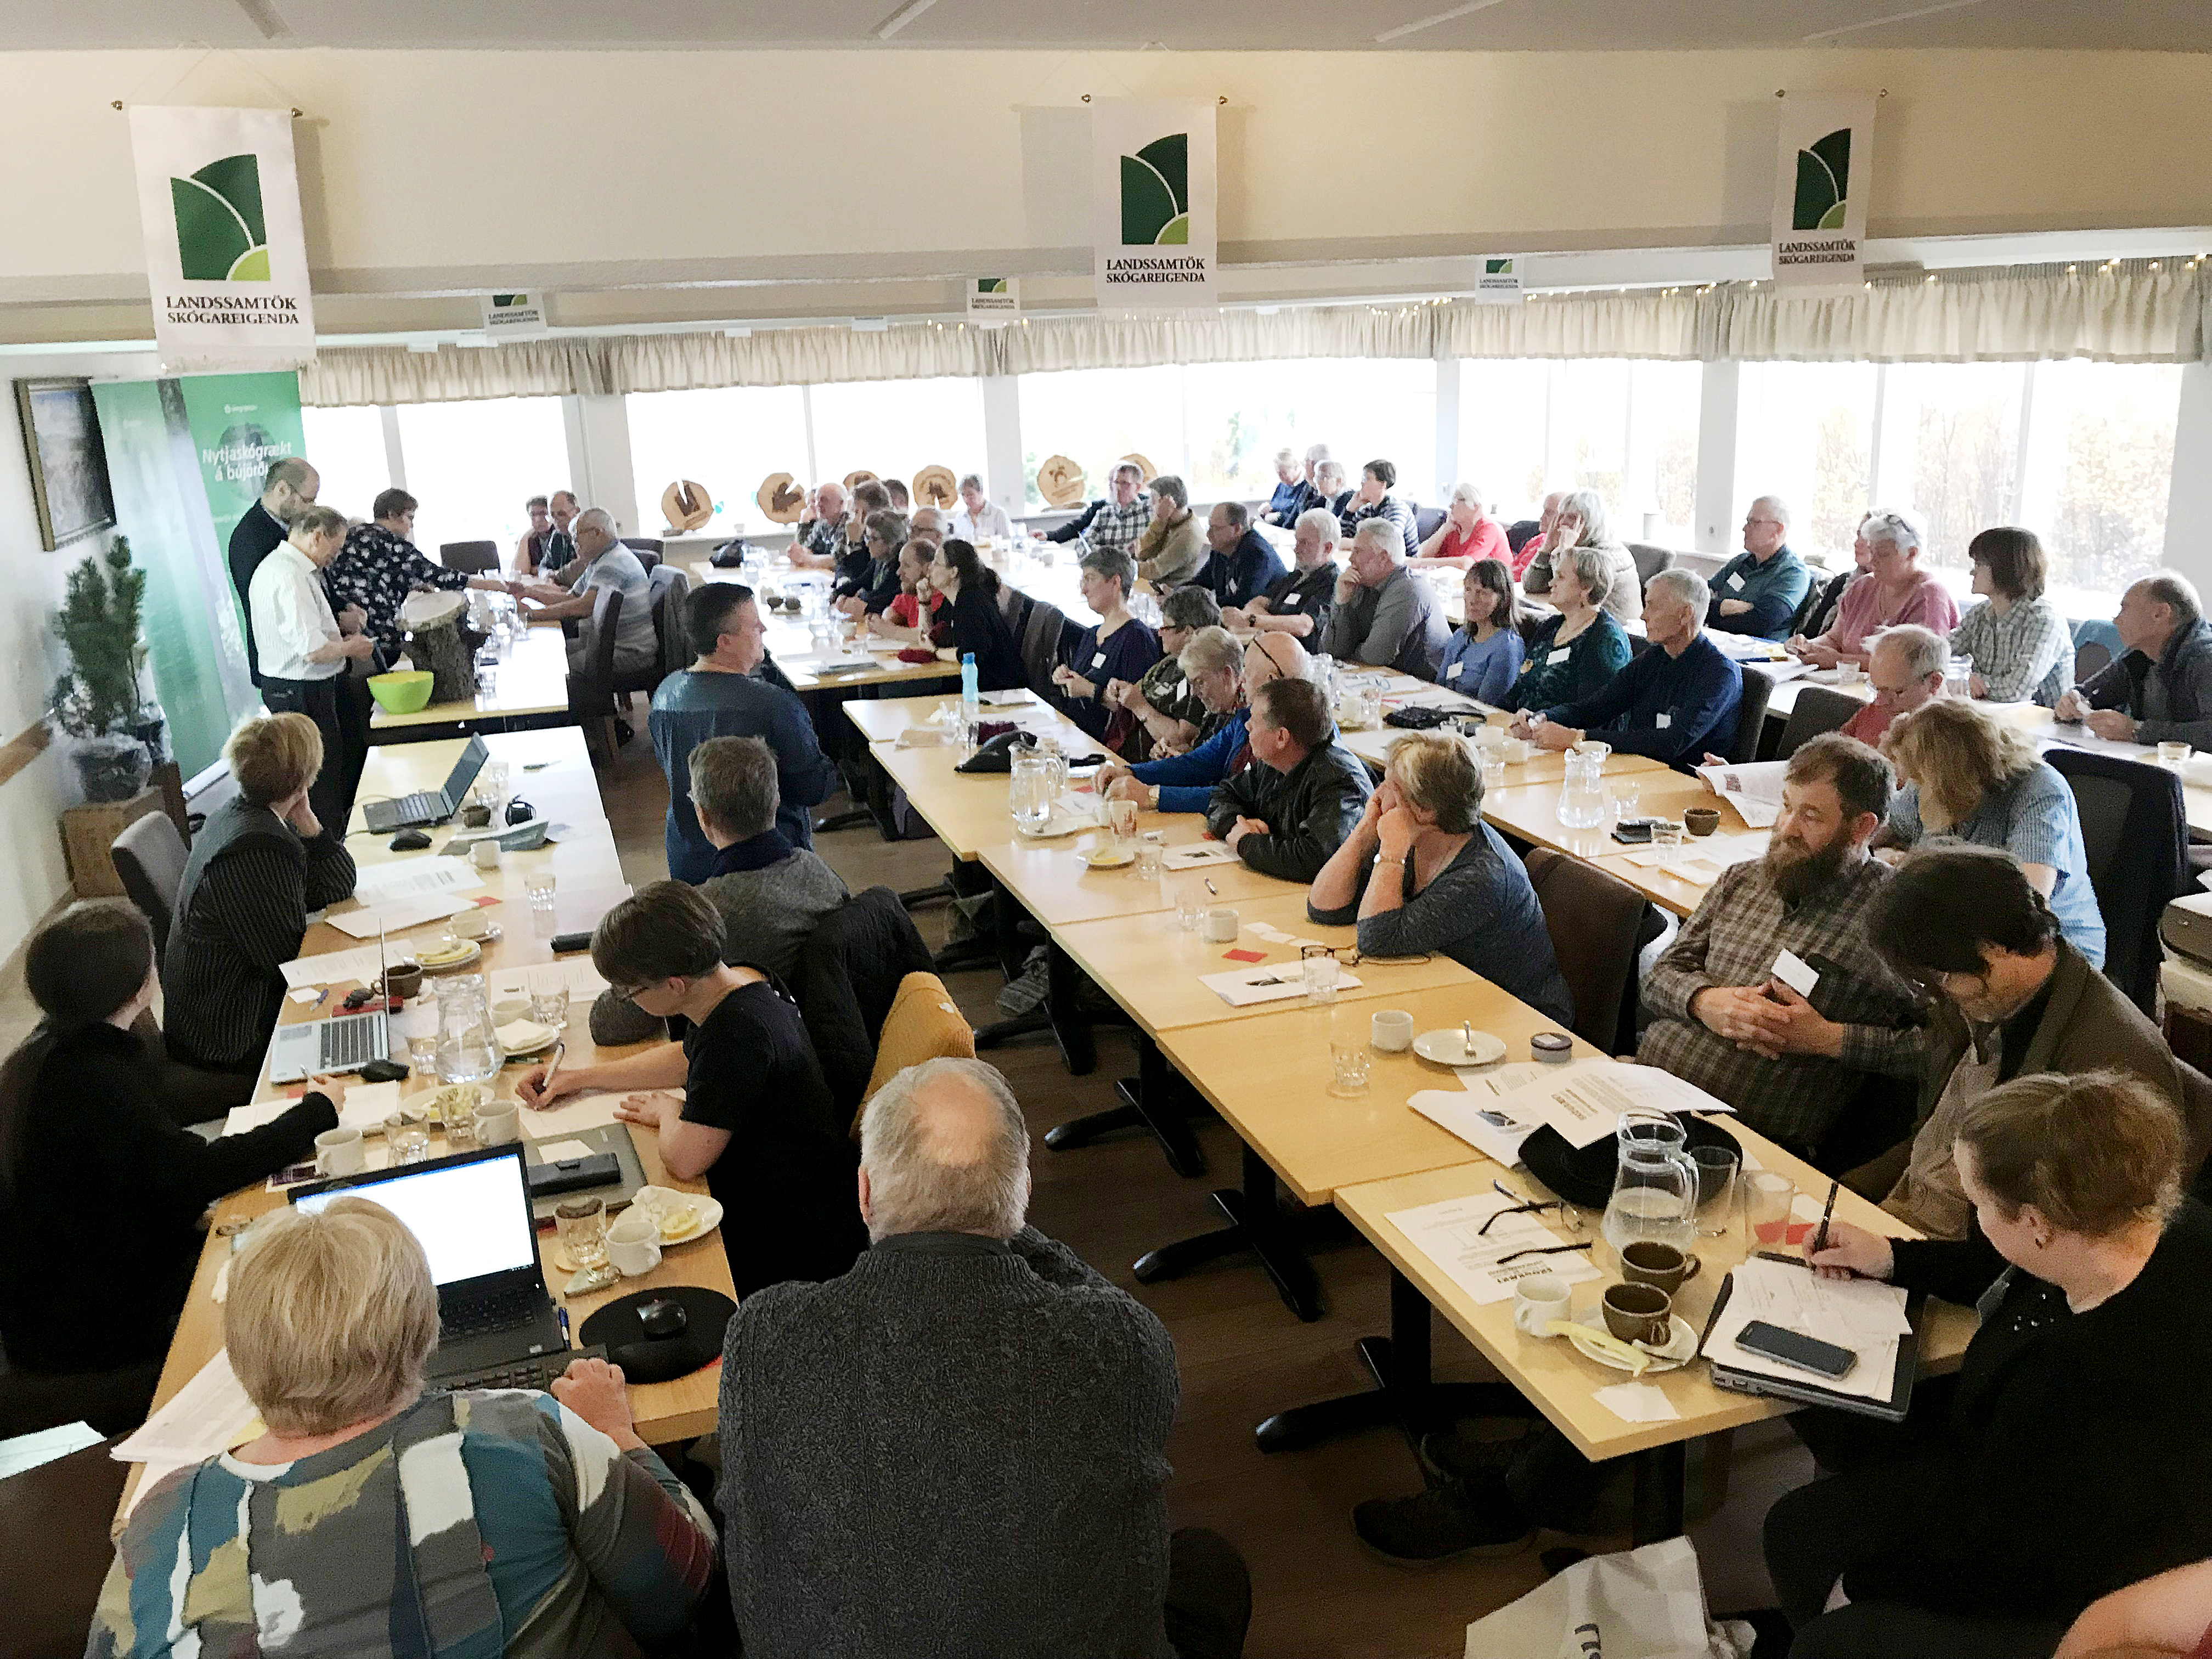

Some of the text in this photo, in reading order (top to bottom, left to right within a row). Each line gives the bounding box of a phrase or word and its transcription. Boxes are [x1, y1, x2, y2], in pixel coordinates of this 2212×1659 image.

[1779, 238, 1856, 253] LANDSSAMTÖK
[1107, 256, 1205, 270] LANDSSAMTÖK
[1779, 253, 1855, 264] SKÓGAREIGENDA
[1107, 271, 1205, 283] SKÓGAREIGENDA
[166, 295, 297, 309] LANDSSAMTÖK
[167, 310, 299, 324] SKÓGAREIGENDA
[202, 441, 292, 466] Nytjaskógrækt
